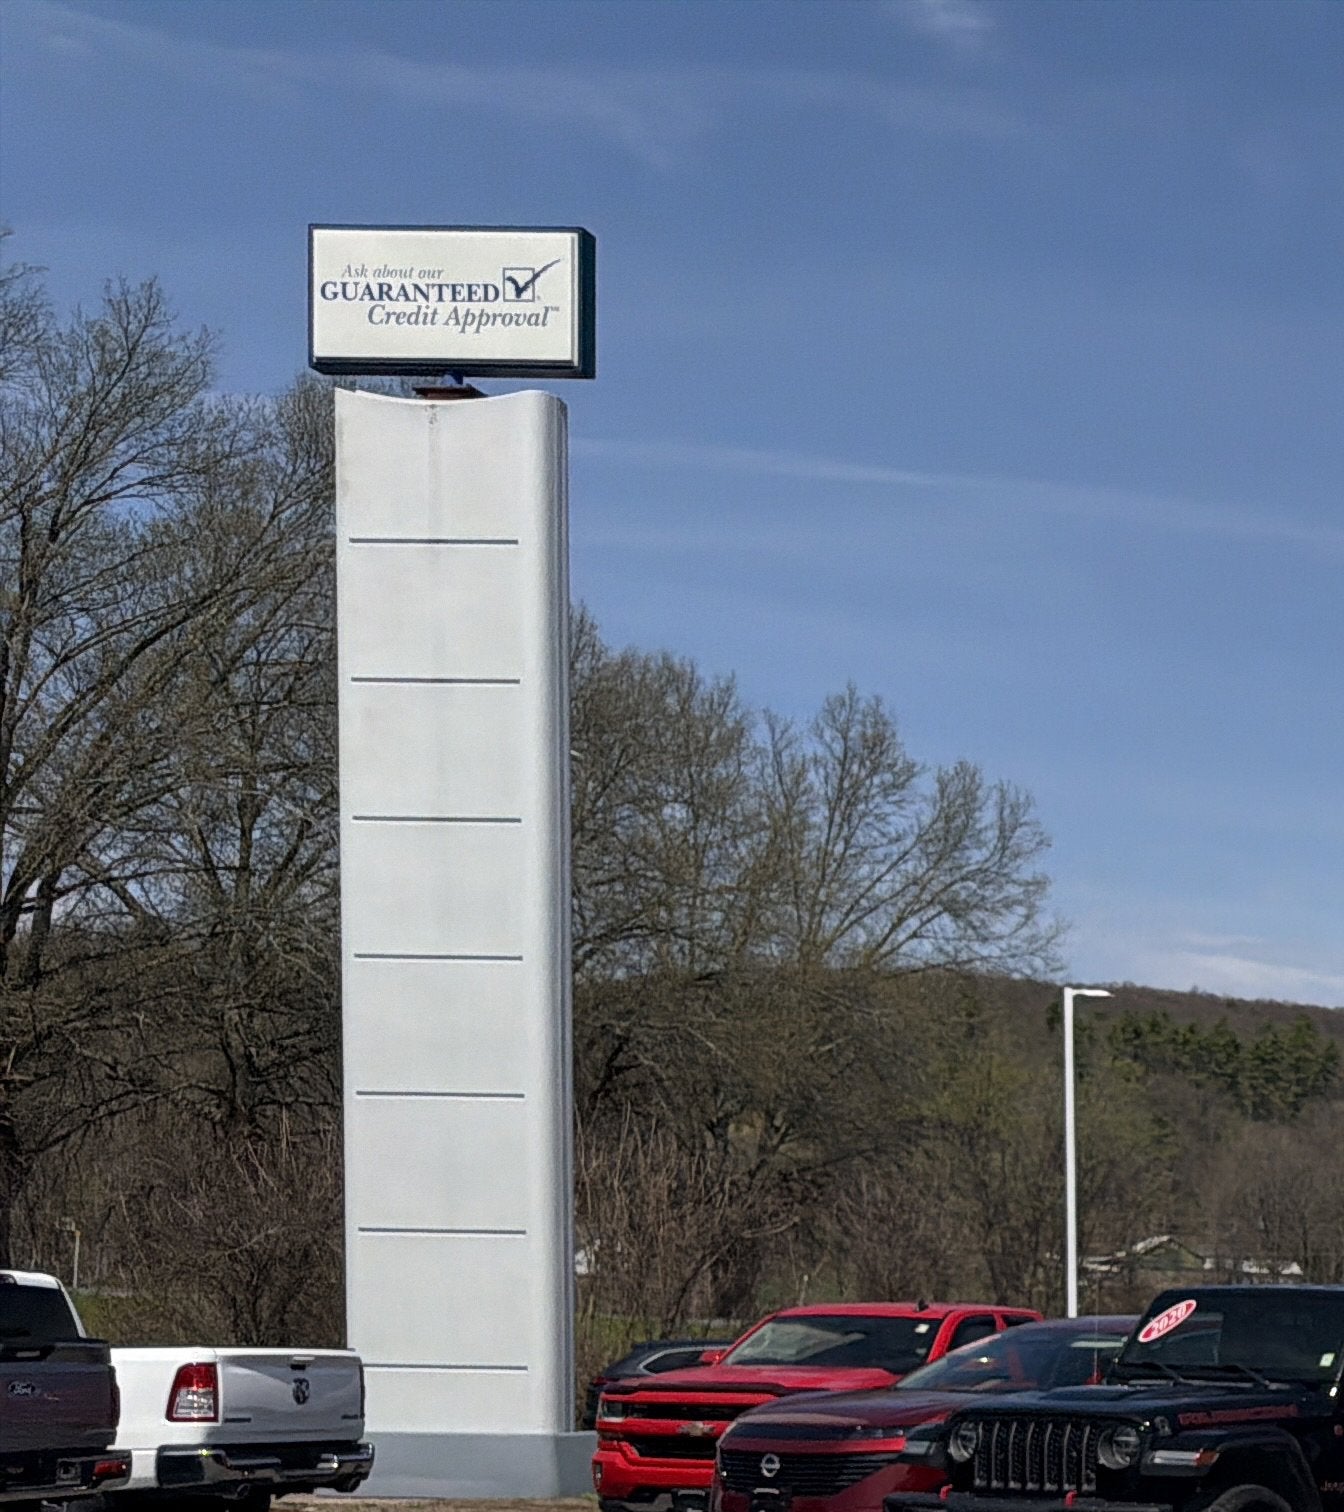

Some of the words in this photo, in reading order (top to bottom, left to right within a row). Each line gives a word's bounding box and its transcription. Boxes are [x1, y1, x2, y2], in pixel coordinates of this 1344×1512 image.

[341, 264, 367, 278] Ask
[372, 264, 414, 279] about
[418, 268, 444, 279] our
[320, 281, 499, 302] GUARANTEED
[367, 304, 438, 326] Credit
[1151, 1305, 1187, 1334] 2020
